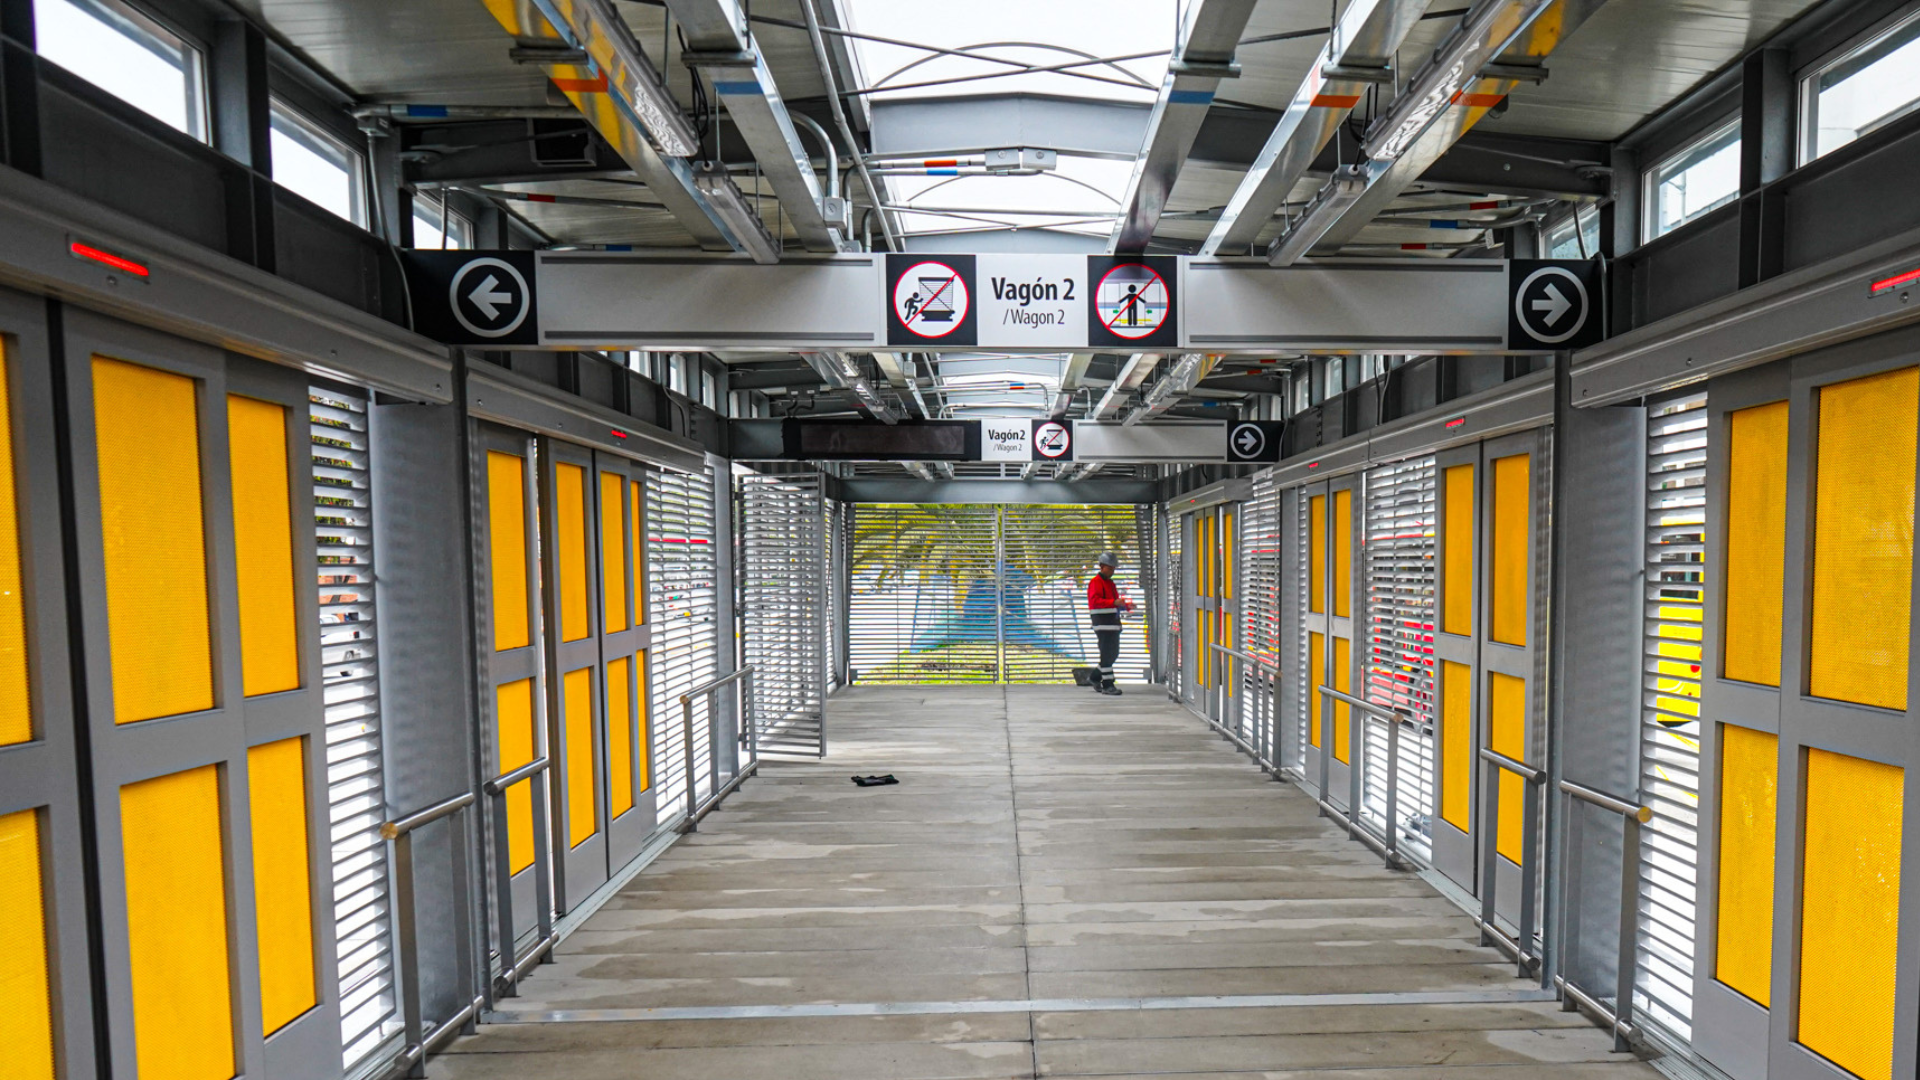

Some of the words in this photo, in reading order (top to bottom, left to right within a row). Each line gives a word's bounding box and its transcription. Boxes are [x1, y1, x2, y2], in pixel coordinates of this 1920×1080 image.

[991, 277, 1058, 306] Vagón
[1063, 278, 1075, 300] 2
[1003, 309, 1055, 329] /Wagon
[1057, 309, 1065, 325] 2
[988, 429, 1019, 443] Vagón
[1020, 429, 1026, 440] 2
